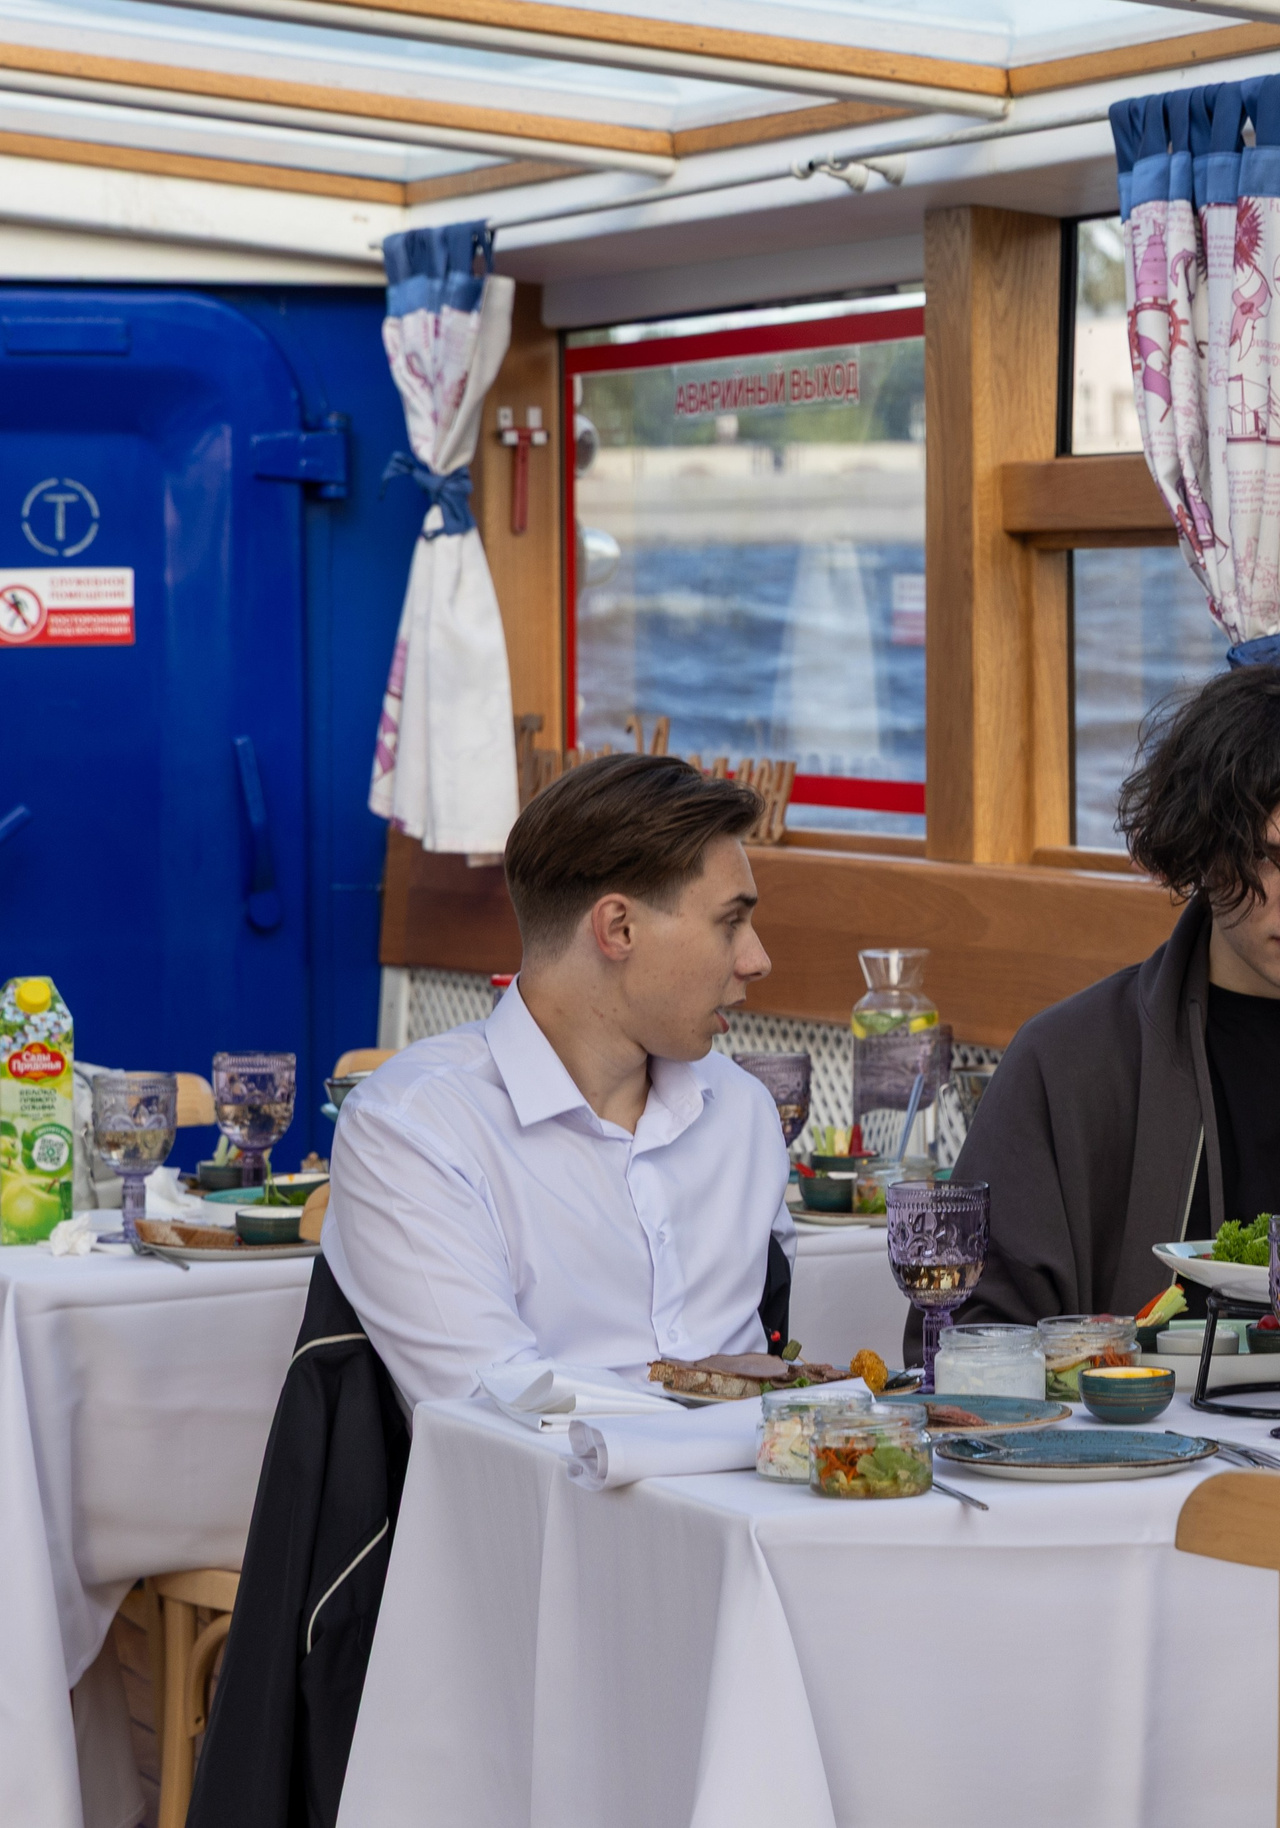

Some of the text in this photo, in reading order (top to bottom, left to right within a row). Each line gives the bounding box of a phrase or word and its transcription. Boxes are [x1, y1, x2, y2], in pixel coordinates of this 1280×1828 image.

[675, 361, 860, 416] АВАРИЙНЫЙ ВЫХОД
[22, 1051, 51, 1062] Сады
[12, 1059, 62, 1073] Придонья
